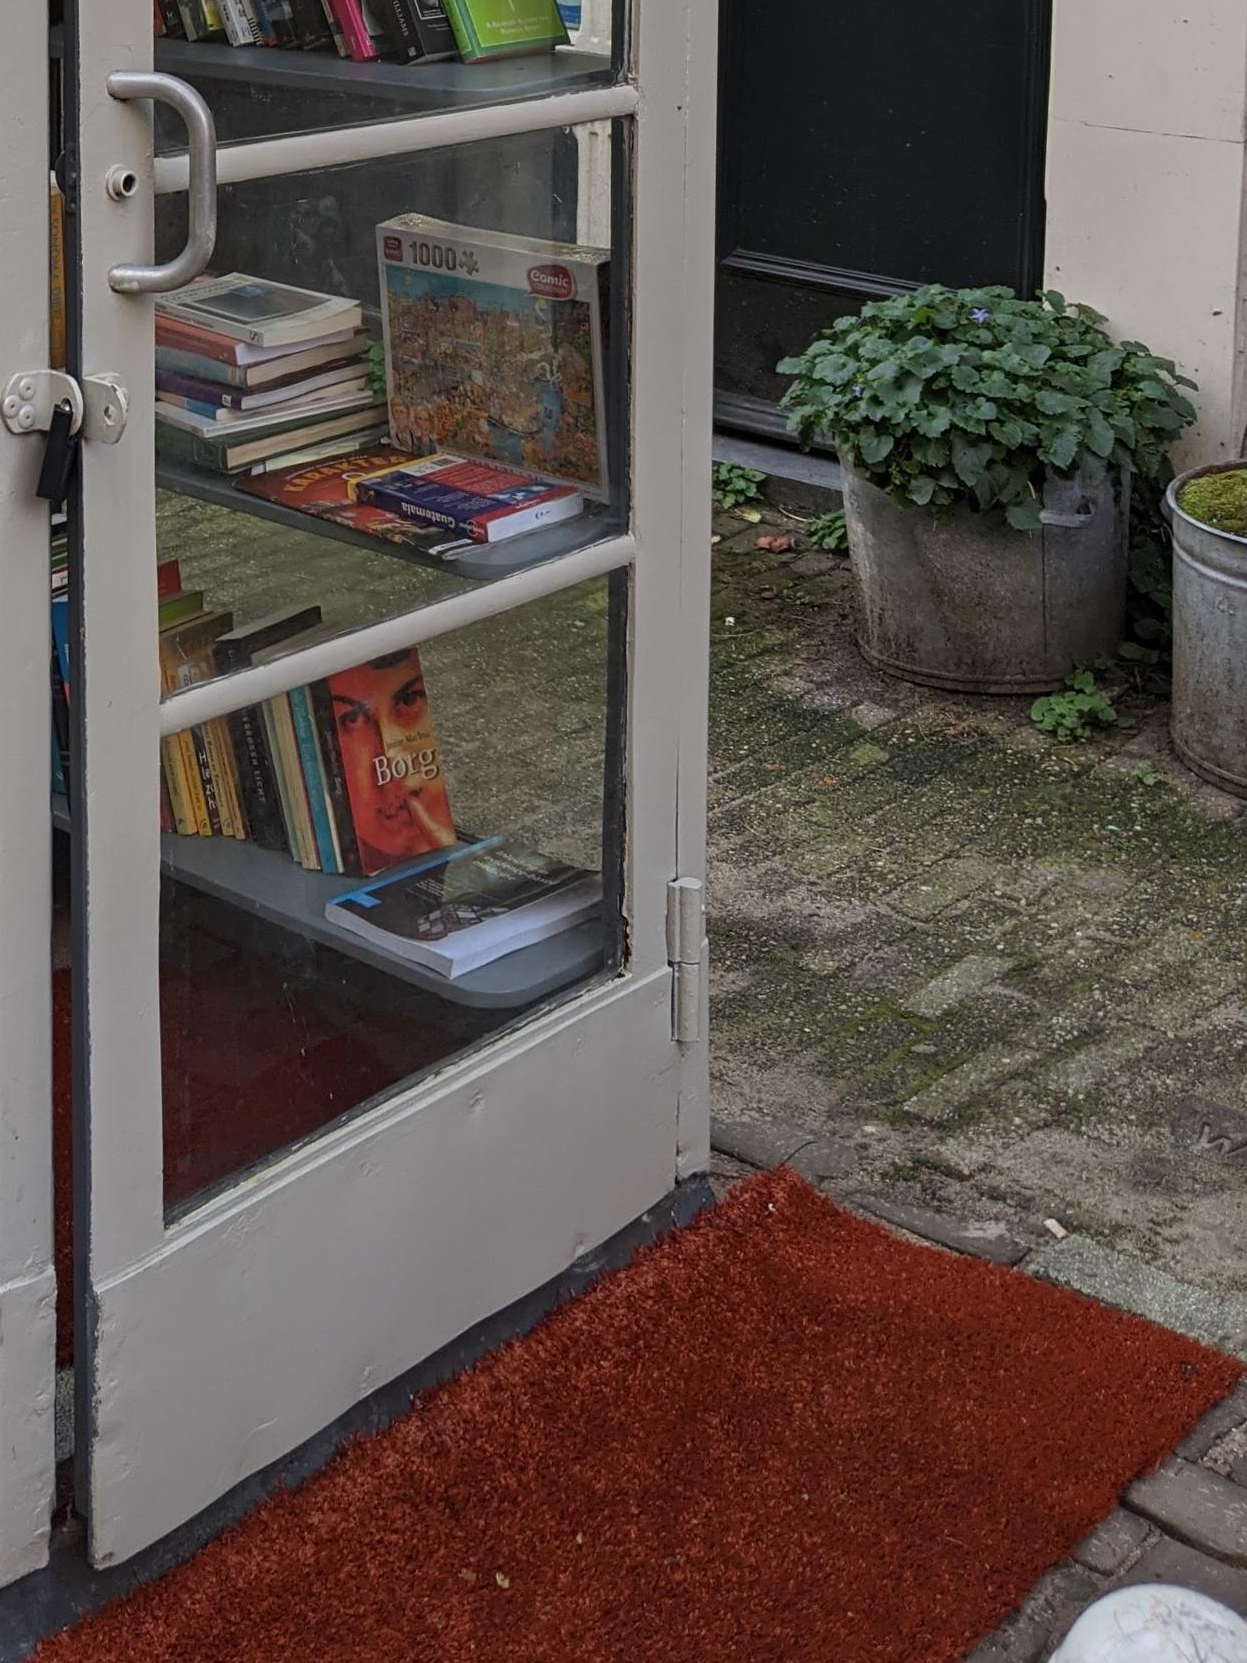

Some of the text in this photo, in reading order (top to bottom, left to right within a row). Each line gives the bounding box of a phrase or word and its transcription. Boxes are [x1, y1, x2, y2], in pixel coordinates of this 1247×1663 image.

[408, 240, 457, 272] 1000
[530, 269, 570, 289] Comic
[400, 500, 456, 530] Guatemala
[372, 748, 439, 786] Borg
